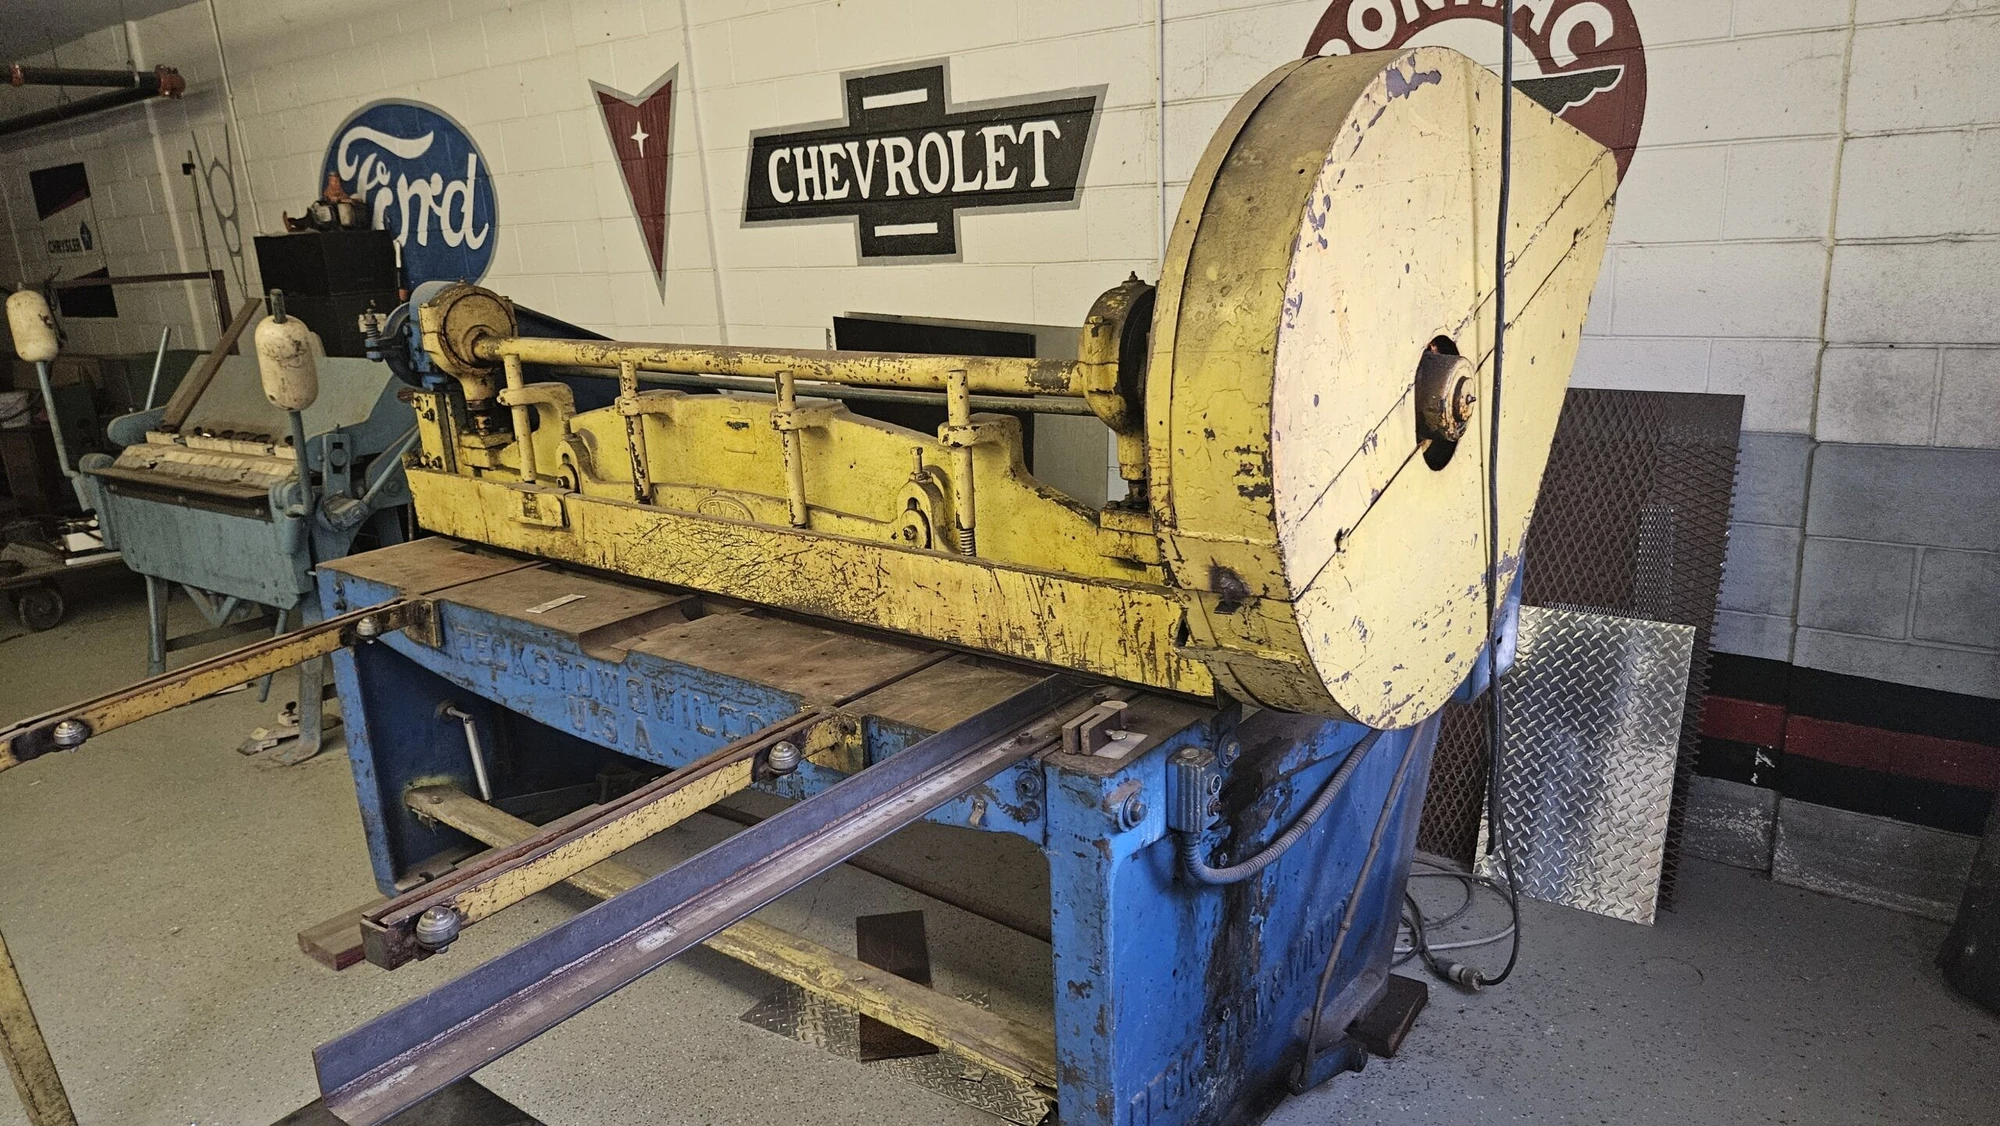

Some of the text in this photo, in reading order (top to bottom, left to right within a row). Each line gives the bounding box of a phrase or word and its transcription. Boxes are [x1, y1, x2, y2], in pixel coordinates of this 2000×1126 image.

[337, 125, 489, 250] Ford
[768, 120, 1060, 203] CHEVROLET
[48, 237, 82, 254] CHRYSLER
[650, 680, 768, 743] WILCO
